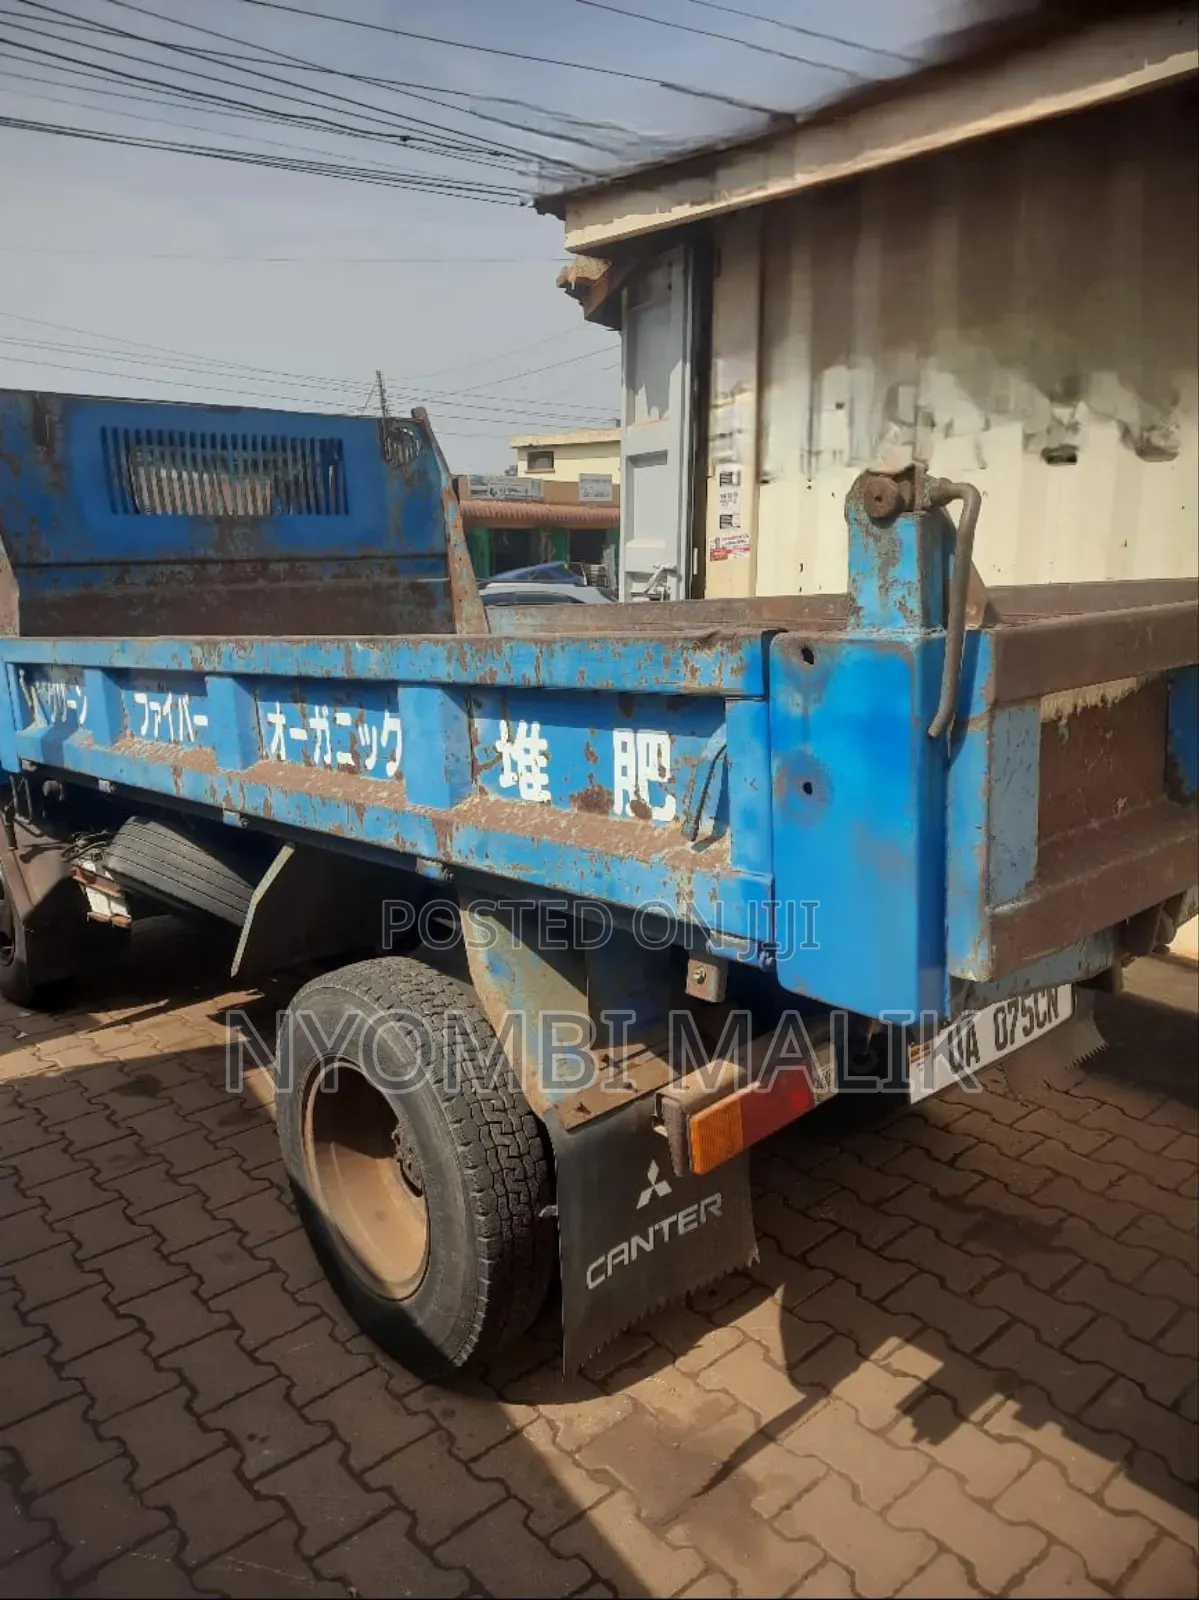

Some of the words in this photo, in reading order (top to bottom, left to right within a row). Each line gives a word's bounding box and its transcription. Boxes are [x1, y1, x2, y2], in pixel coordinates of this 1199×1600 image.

[134, 692, 208, 742] ファイバー
[267, 701, 402, 777] オーガニック
[993, 989, 1059, 1052] 075CN
[586, 1192, 724, 1291] CANTER
